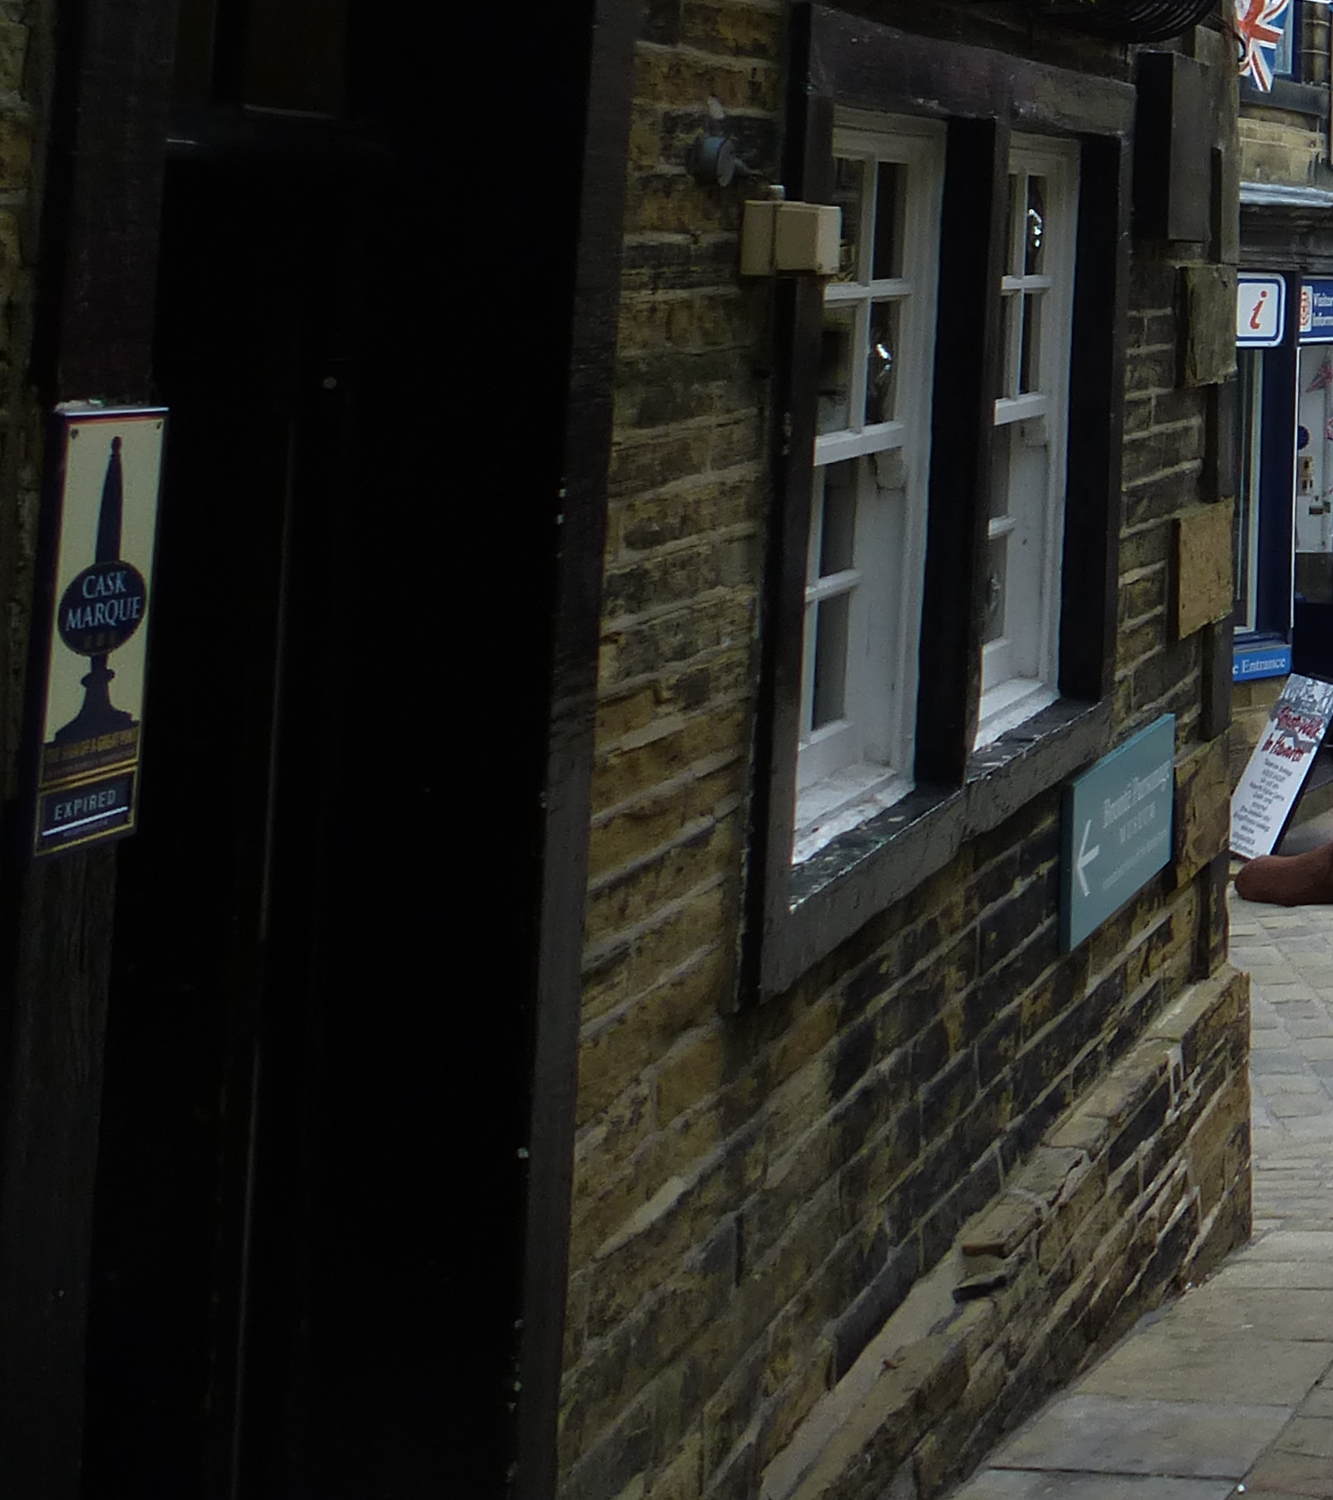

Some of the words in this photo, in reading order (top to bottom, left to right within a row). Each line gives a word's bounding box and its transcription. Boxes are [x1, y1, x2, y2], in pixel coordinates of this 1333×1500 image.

[82, 570, 128, 599] CASK
[65, 596, 141, 631] MARQUE
[1241, 657, 1286, 674] Entrance
[54, 789, 117, 821] EXPIRED
